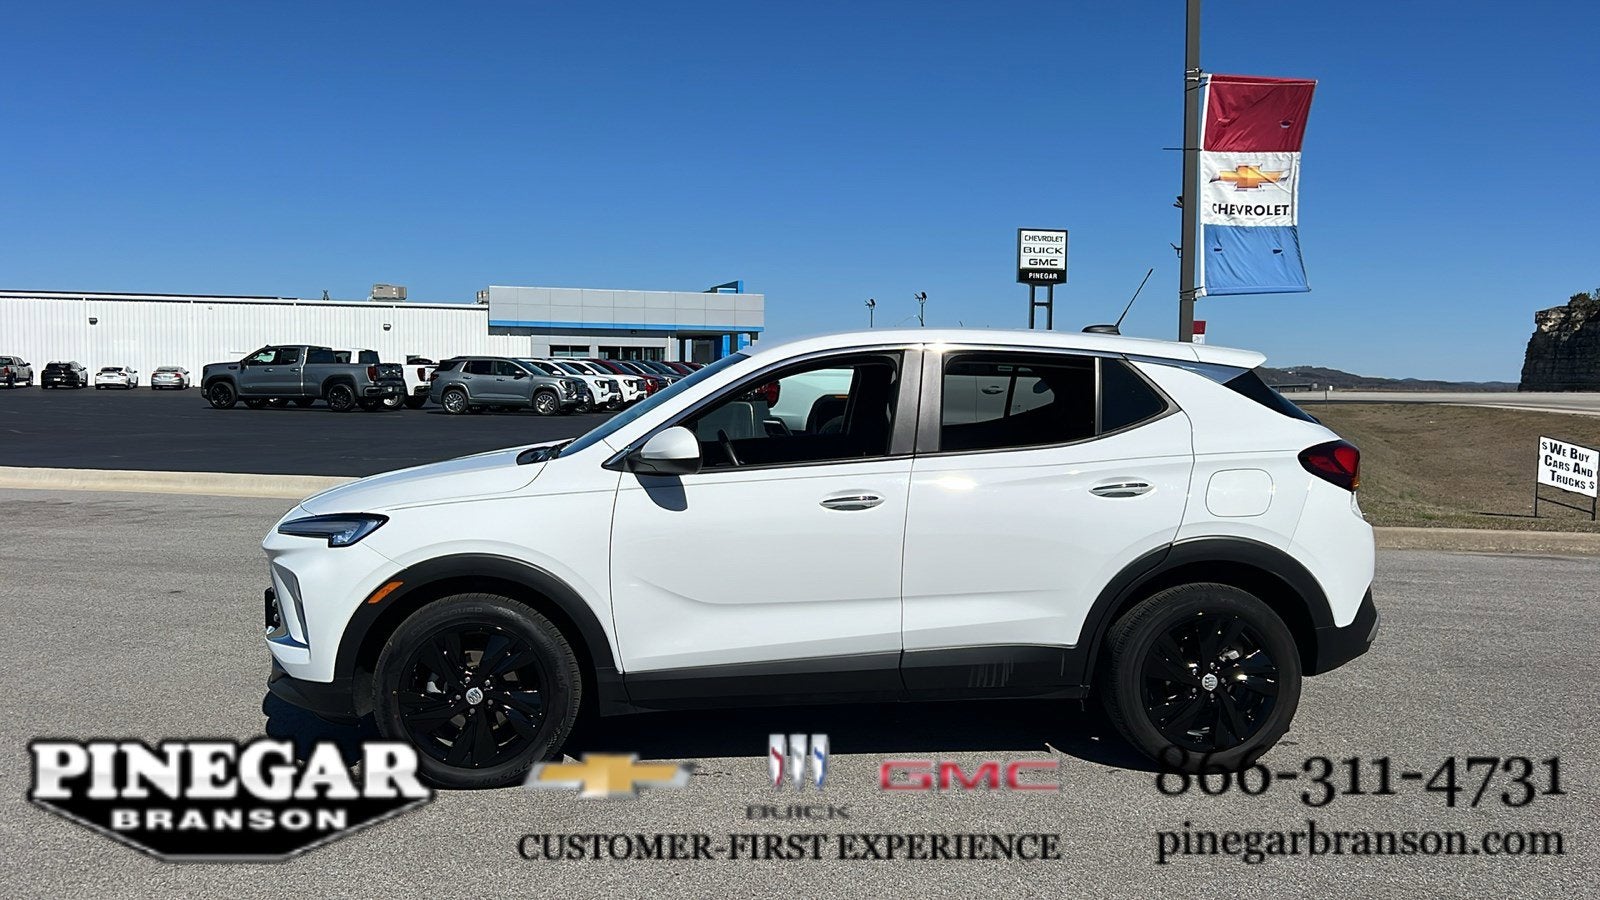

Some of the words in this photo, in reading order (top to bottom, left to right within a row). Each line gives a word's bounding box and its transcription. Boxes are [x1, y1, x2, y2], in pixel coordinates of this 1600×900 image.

[1212, 203, 1290, 217] CHEVROLET
[1024, 234, 1063, 243] CHEVROLET
[1023, 246, 1063, 254] BUICK
[1028, 258, 1058, 266] GMC
[1028, 272, 1058, 280] PINEGAR
